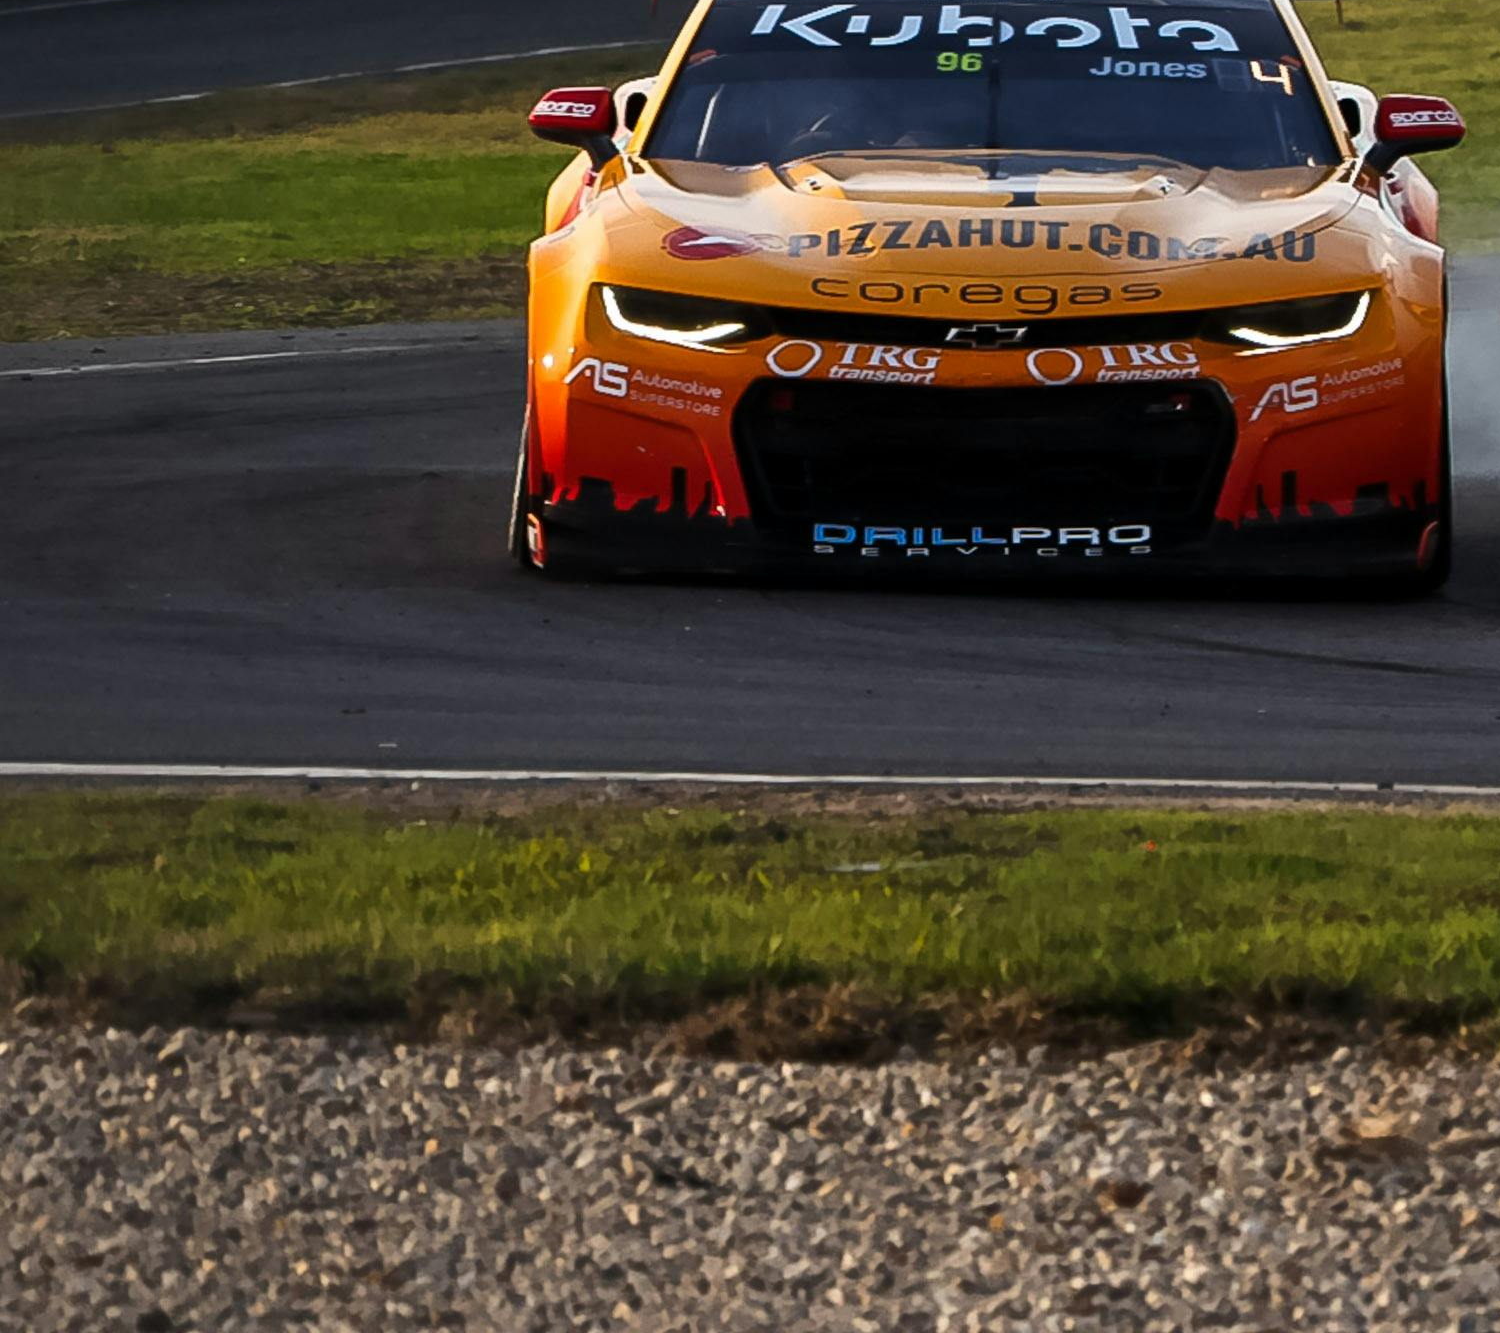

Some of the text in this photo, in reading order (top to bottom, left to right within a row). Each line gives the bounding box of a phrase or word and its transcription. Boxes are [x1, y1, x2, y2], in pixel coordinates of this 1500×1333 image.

[750, 4, 1240, 53] Kubota
[935, 51, 984, 72] 96
[1088, 55, 1208, 80] Jones
[1249, 59, 1295, 96] 4
[534, 100, 597, 117] sparco
[1388, 109, 1460, 127] sparco
[788, 217, 1316, 263] PIZZAHUT.COM.AU
[811, 277, 1164, 315] coregas
[837, 342, 942, 371] TRG
[1086, 341, 1200, 367] TRG
[630, 369, 723, 400] Automotive
[828, 364, 936, 386] transport
[1095, 364, 1200, 383] transport
[1320, 356, 1404, 388] Automotive
[629, 389, 721, 416] SUPERSTORE
[1319, 374, 1406, 405] SUPERSTORE
[812, 523, 1152, 546] DRILLPRO
[812, 544, 1152, 558] SERVICES
